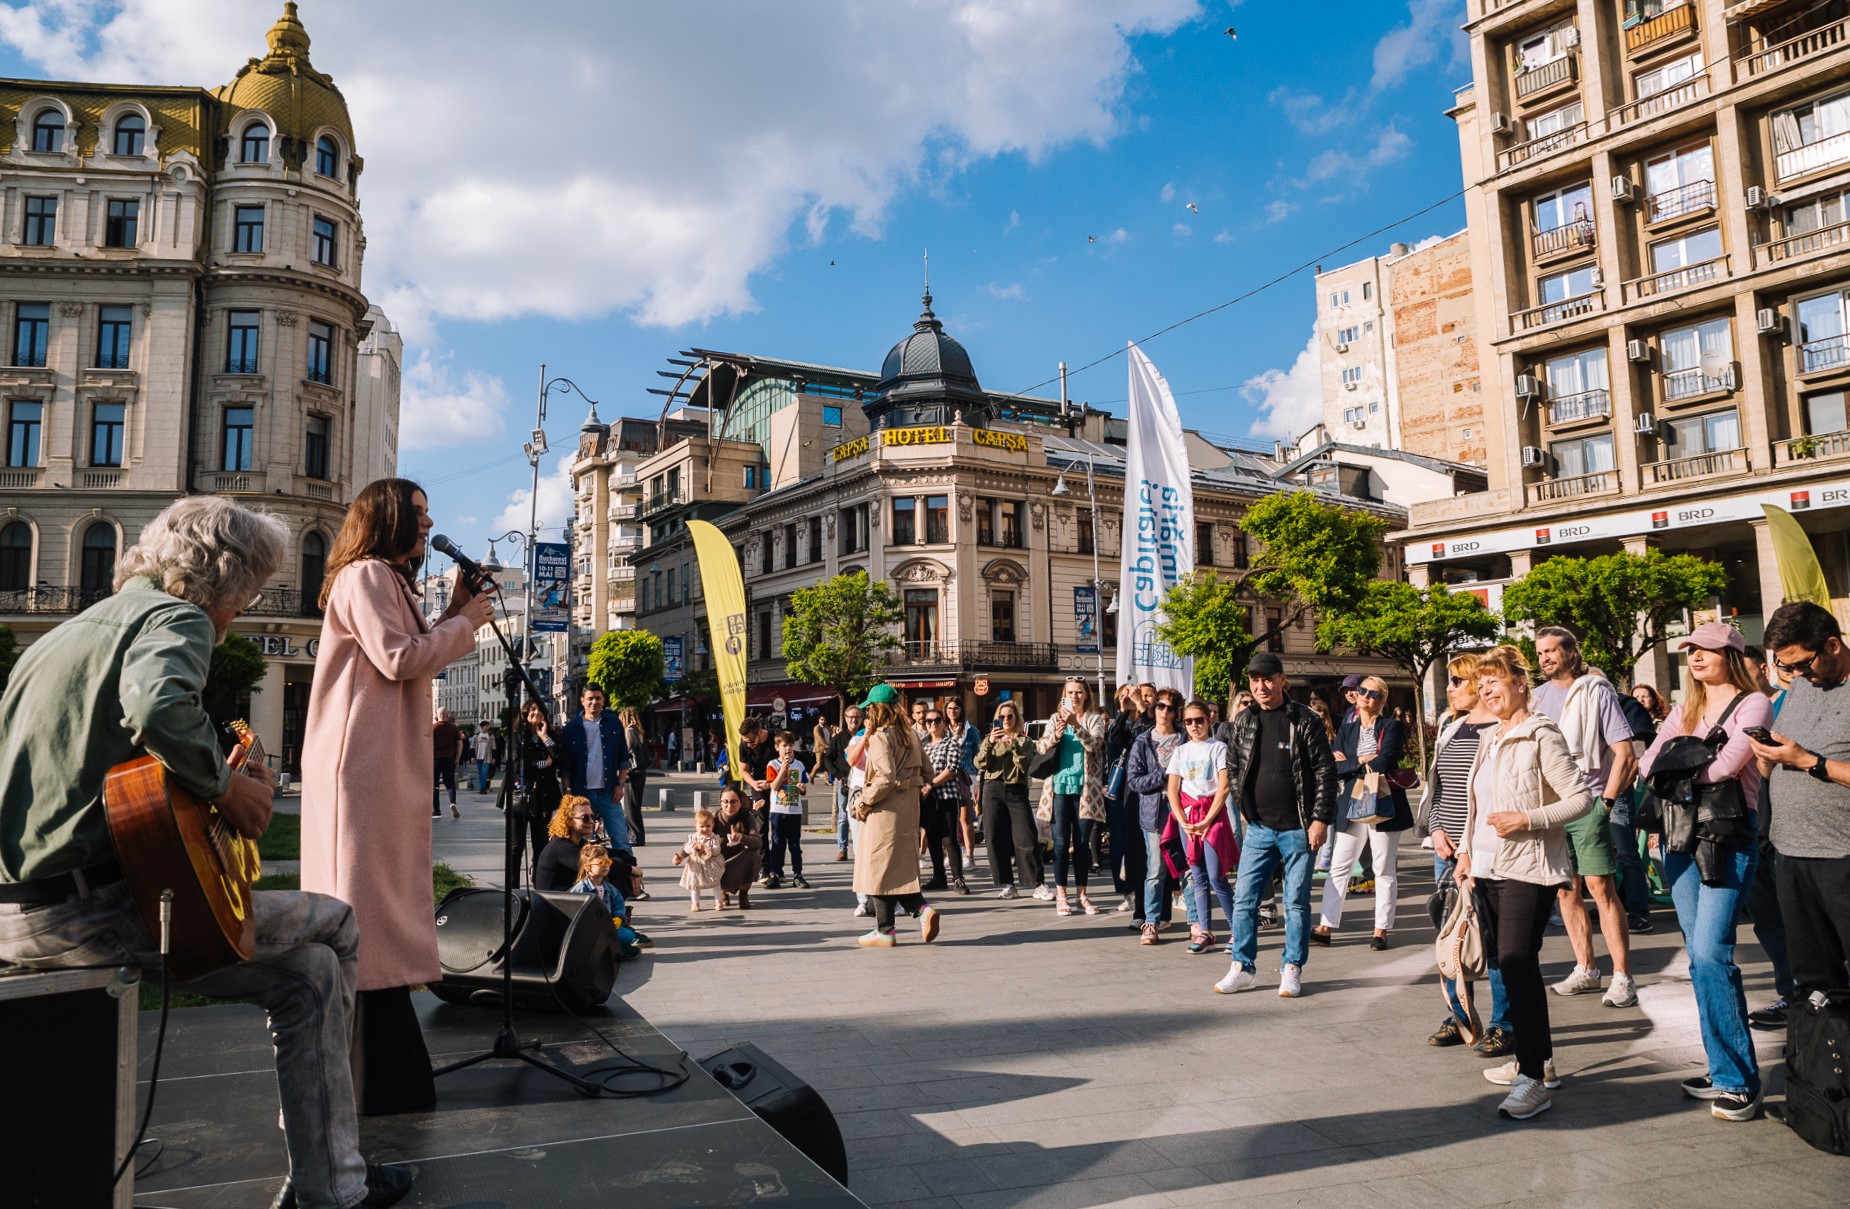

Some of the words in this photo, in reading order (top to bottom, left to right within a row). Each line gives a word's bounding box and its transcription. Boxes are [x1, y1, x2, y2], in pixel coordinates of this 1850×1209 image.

[884, 427, 951, 446] HOTEL
[1822, 490, 1850, 502] BR
[1678, 508, 1714, 521] BRD
[1560, 525, 1590, 538] BRD
[1452, 541, 1480, 553] BRD
[538, 554, 567, 562] Bucharest
